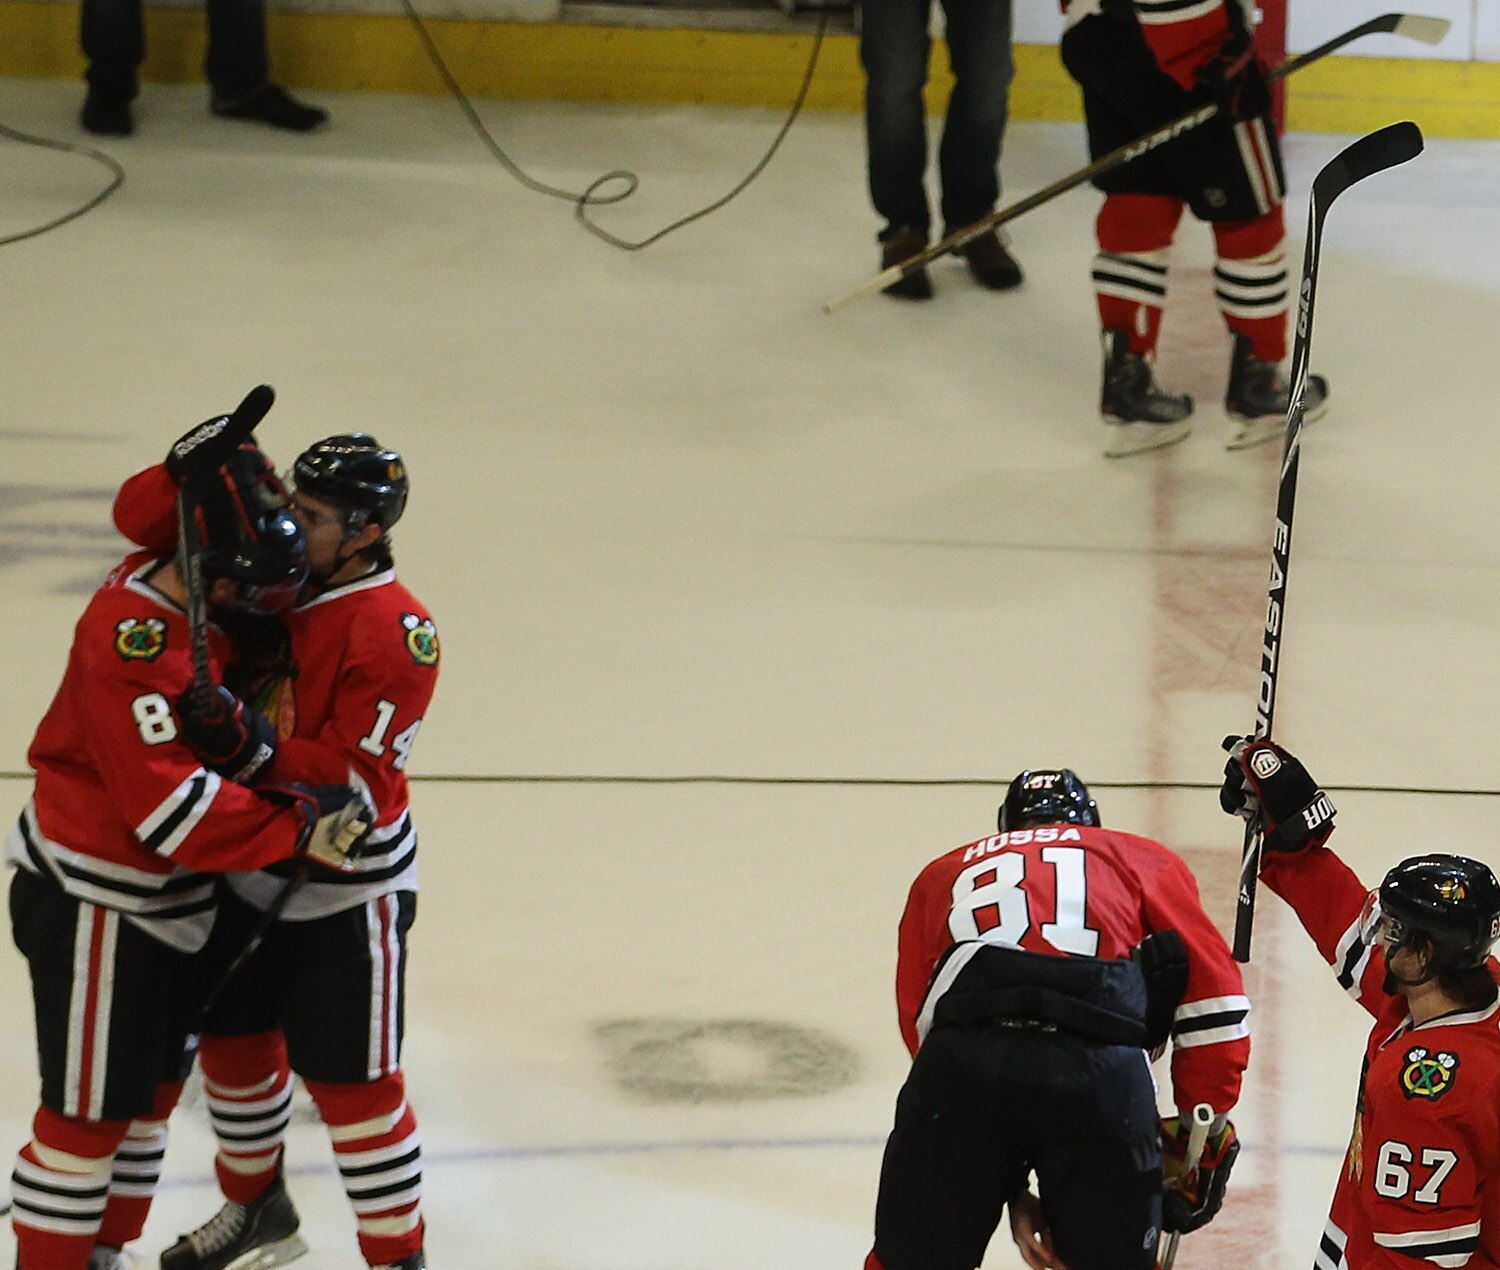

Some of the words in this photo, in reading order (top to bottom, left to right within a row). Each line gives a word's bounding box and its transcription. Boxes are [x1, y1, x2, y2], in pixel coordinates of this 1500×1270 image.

[1253, 517, 1289, 742] EASTON
[358, 699, 422, 770] 14
[963, 827, 1082, 864] HOSSA
[948, 847, 1100, 958] 81
[1374, 1140, 1458, 1204] 67
